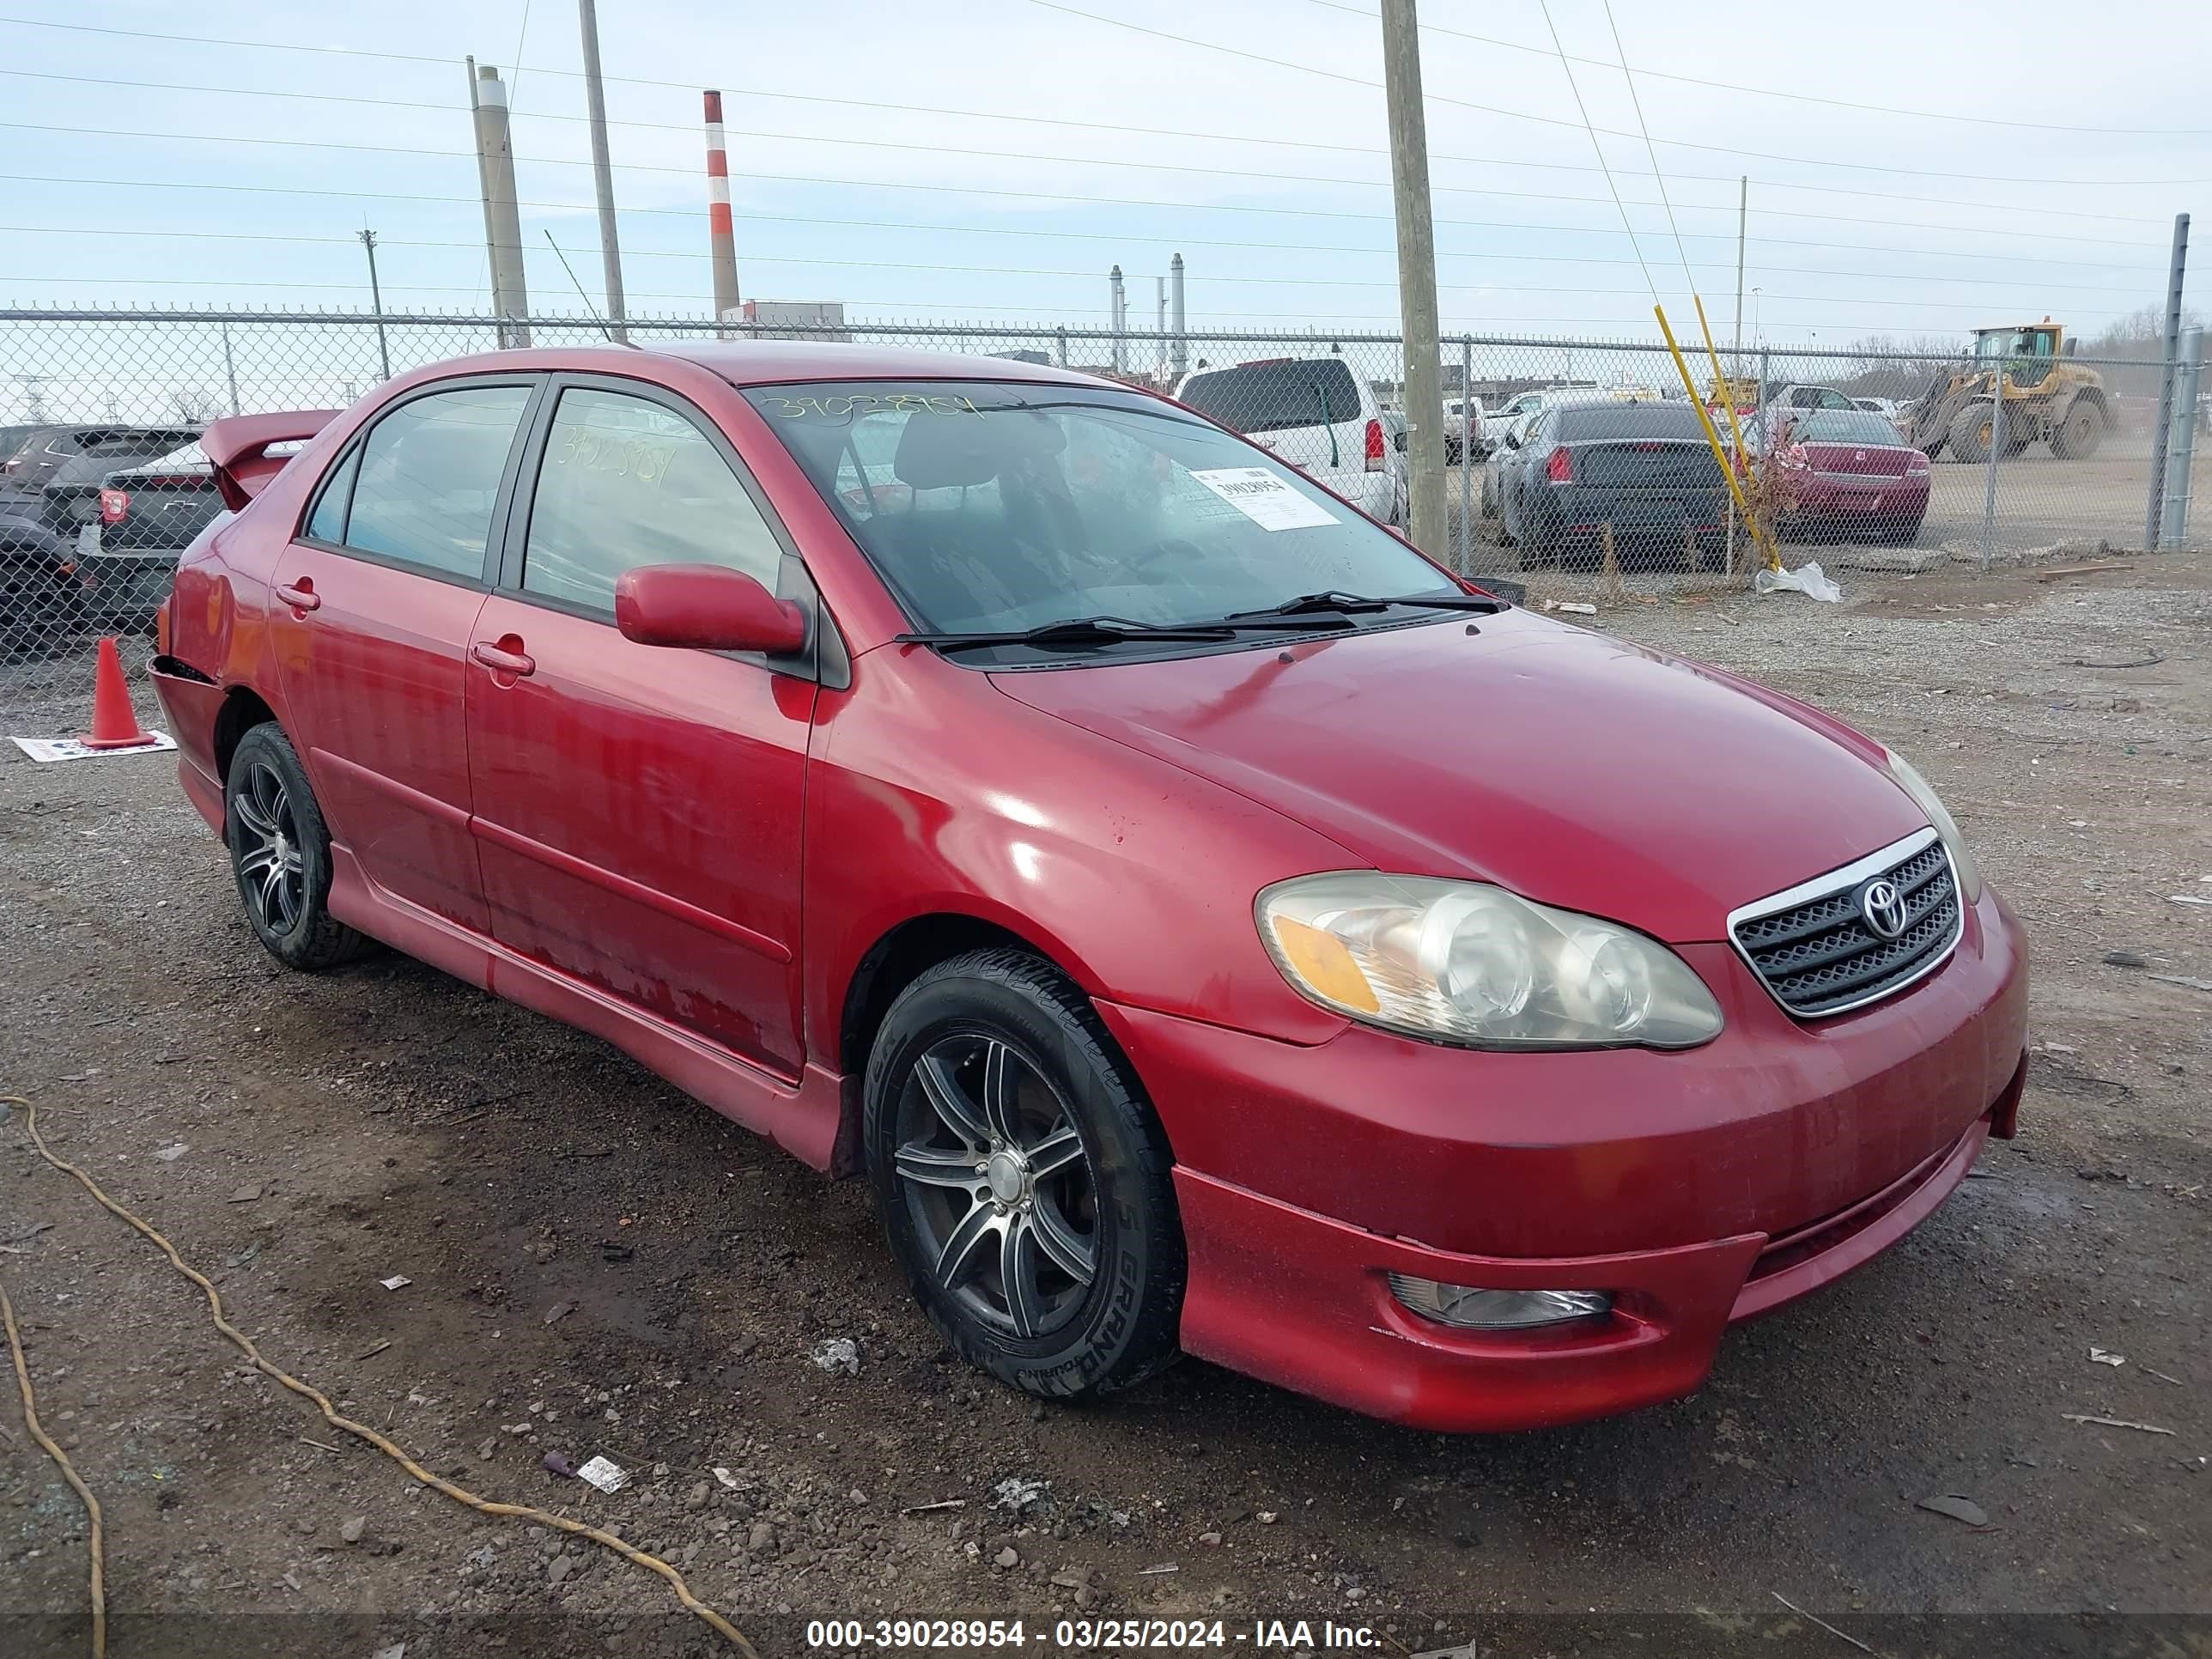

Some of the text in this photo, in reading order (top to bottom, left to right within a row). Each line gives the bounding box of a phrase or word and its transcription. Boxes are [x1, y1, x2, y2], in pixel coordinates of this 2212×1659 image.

[763, 394, 987, 420] 39028954
[1218, 480, 1285, 495] 39028954
[1083, 1251, 1139, 1372] GRAND
